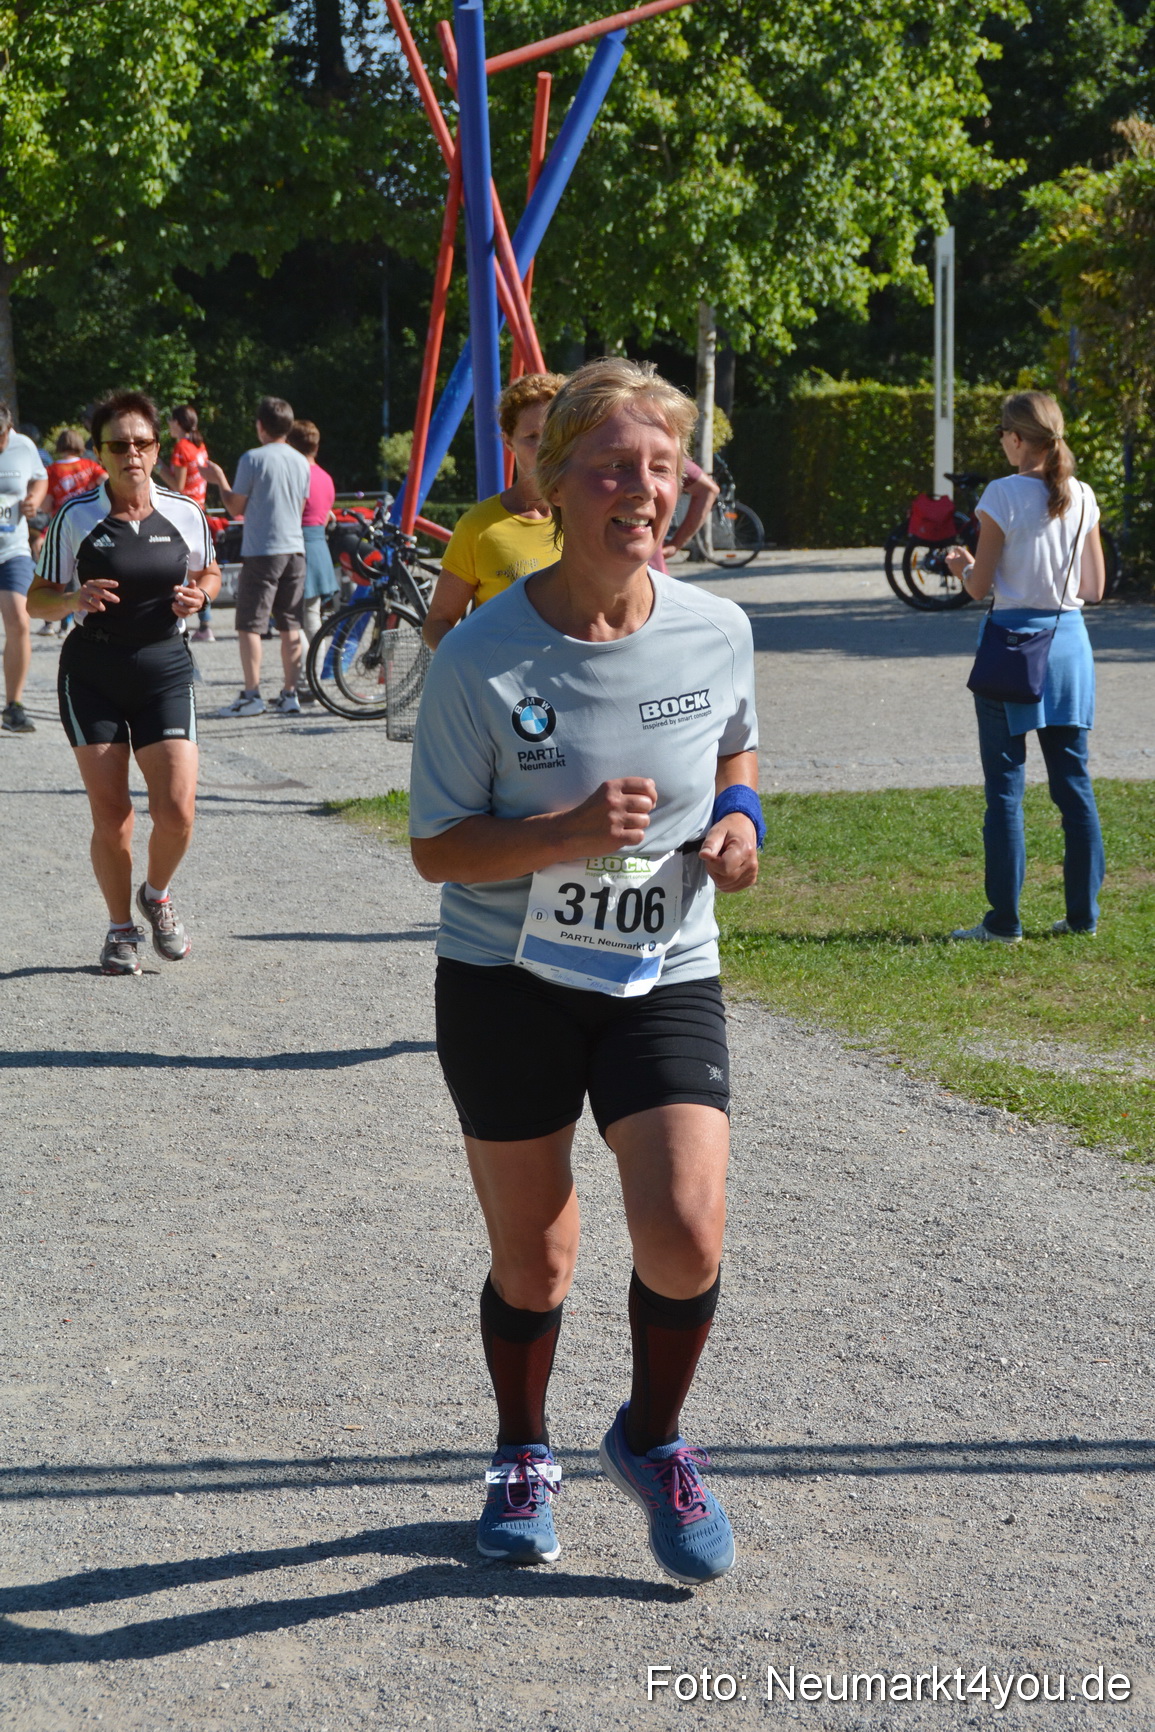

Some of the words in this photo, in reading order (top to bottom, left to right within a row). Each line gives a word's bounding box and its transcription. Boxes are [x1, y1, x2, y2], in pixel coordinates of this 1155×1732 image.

[514, 697, 551, 715] BMW
[639, 688, 711, 723] BOCK
[642, 719, 669, 731] inspired
[517, 747, 565, 763] PARTL
[520, 759, 567, 771] Neumarkt
[586, 856, 651, 873] BOCK
[554, 882, 666, 934] 3106
[560, 931, 596, 945] PARTL
[597, 937, 646, 951] Neumarkt
